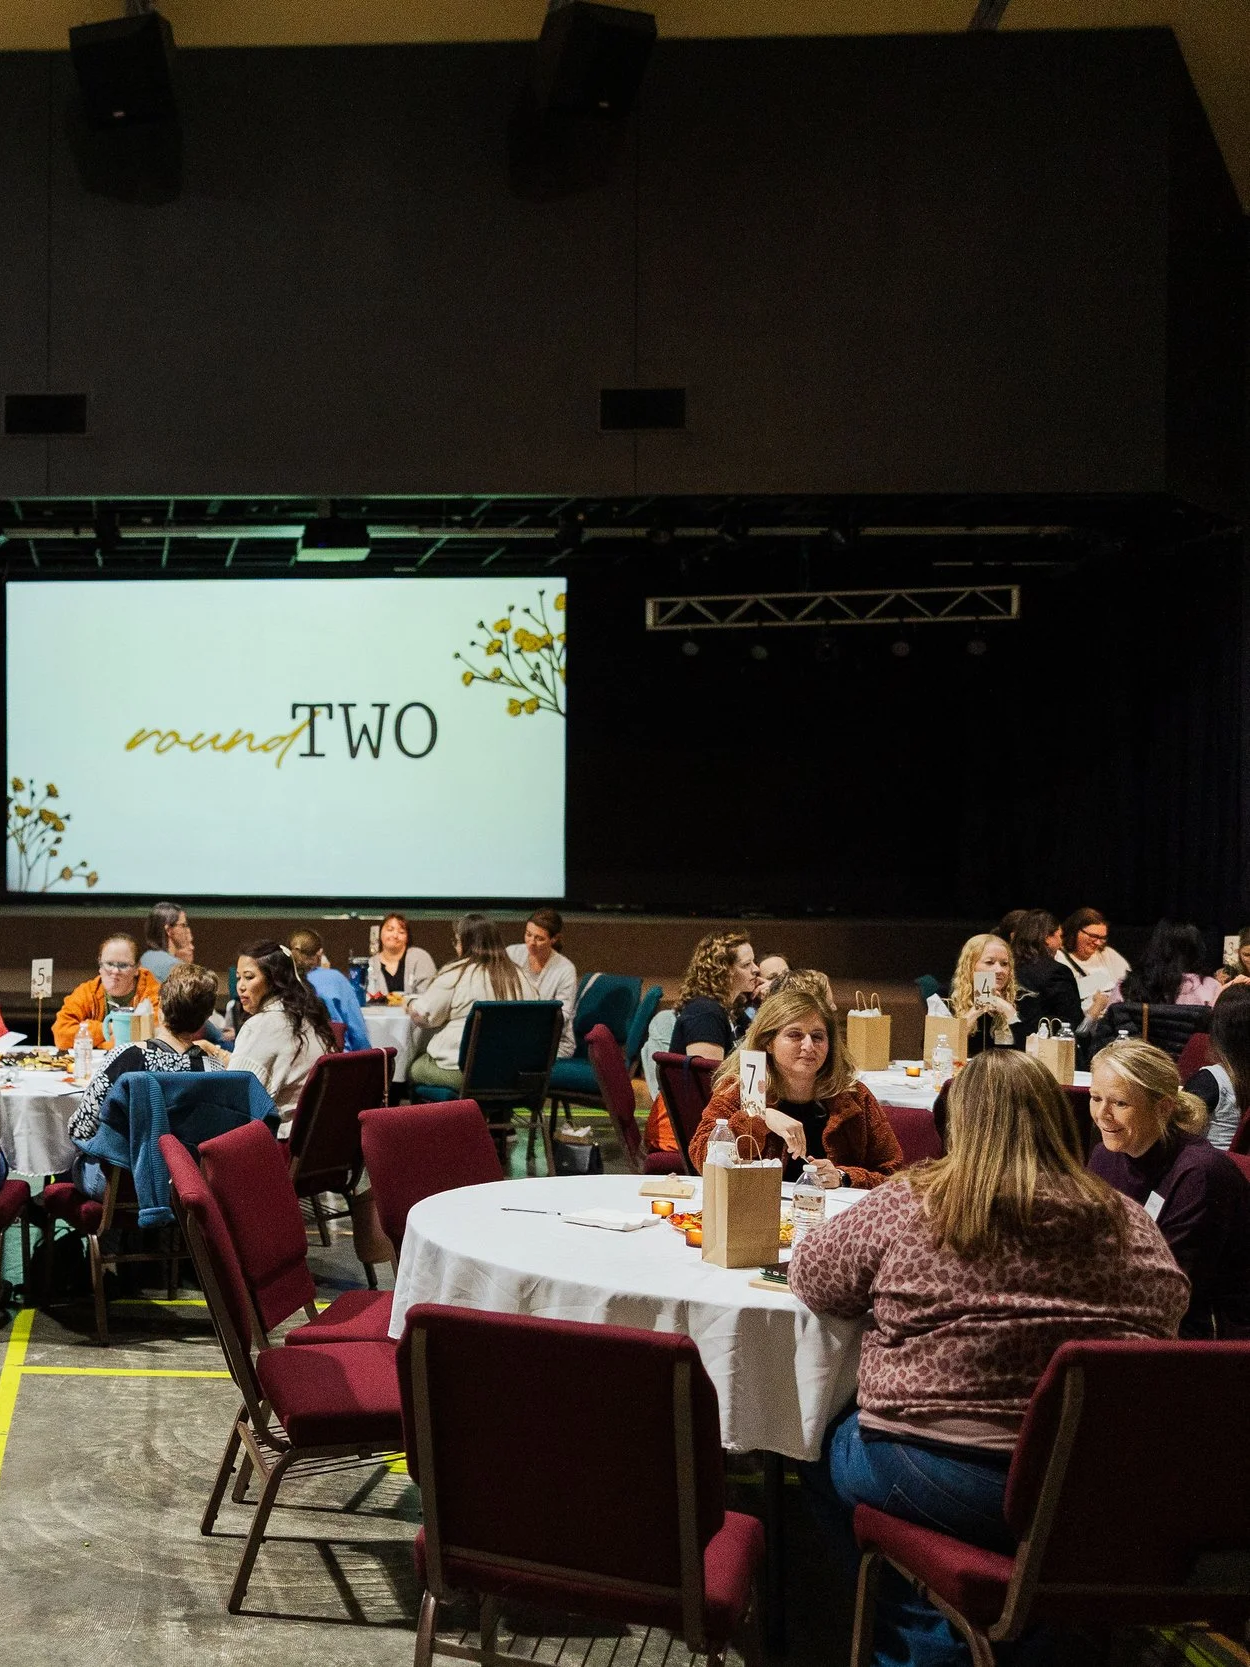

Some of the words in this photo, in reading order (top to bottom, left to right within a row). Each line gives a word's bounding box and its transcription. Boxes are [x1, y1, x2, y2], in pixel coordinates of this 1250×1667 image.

[126, 708, 321, 768] round
[291, 702, 438, 759] TWO
[37, 967, 45, 986] 5
[981, 978, 991, 998] 4
[746, 1063, 756, 1095] 7
